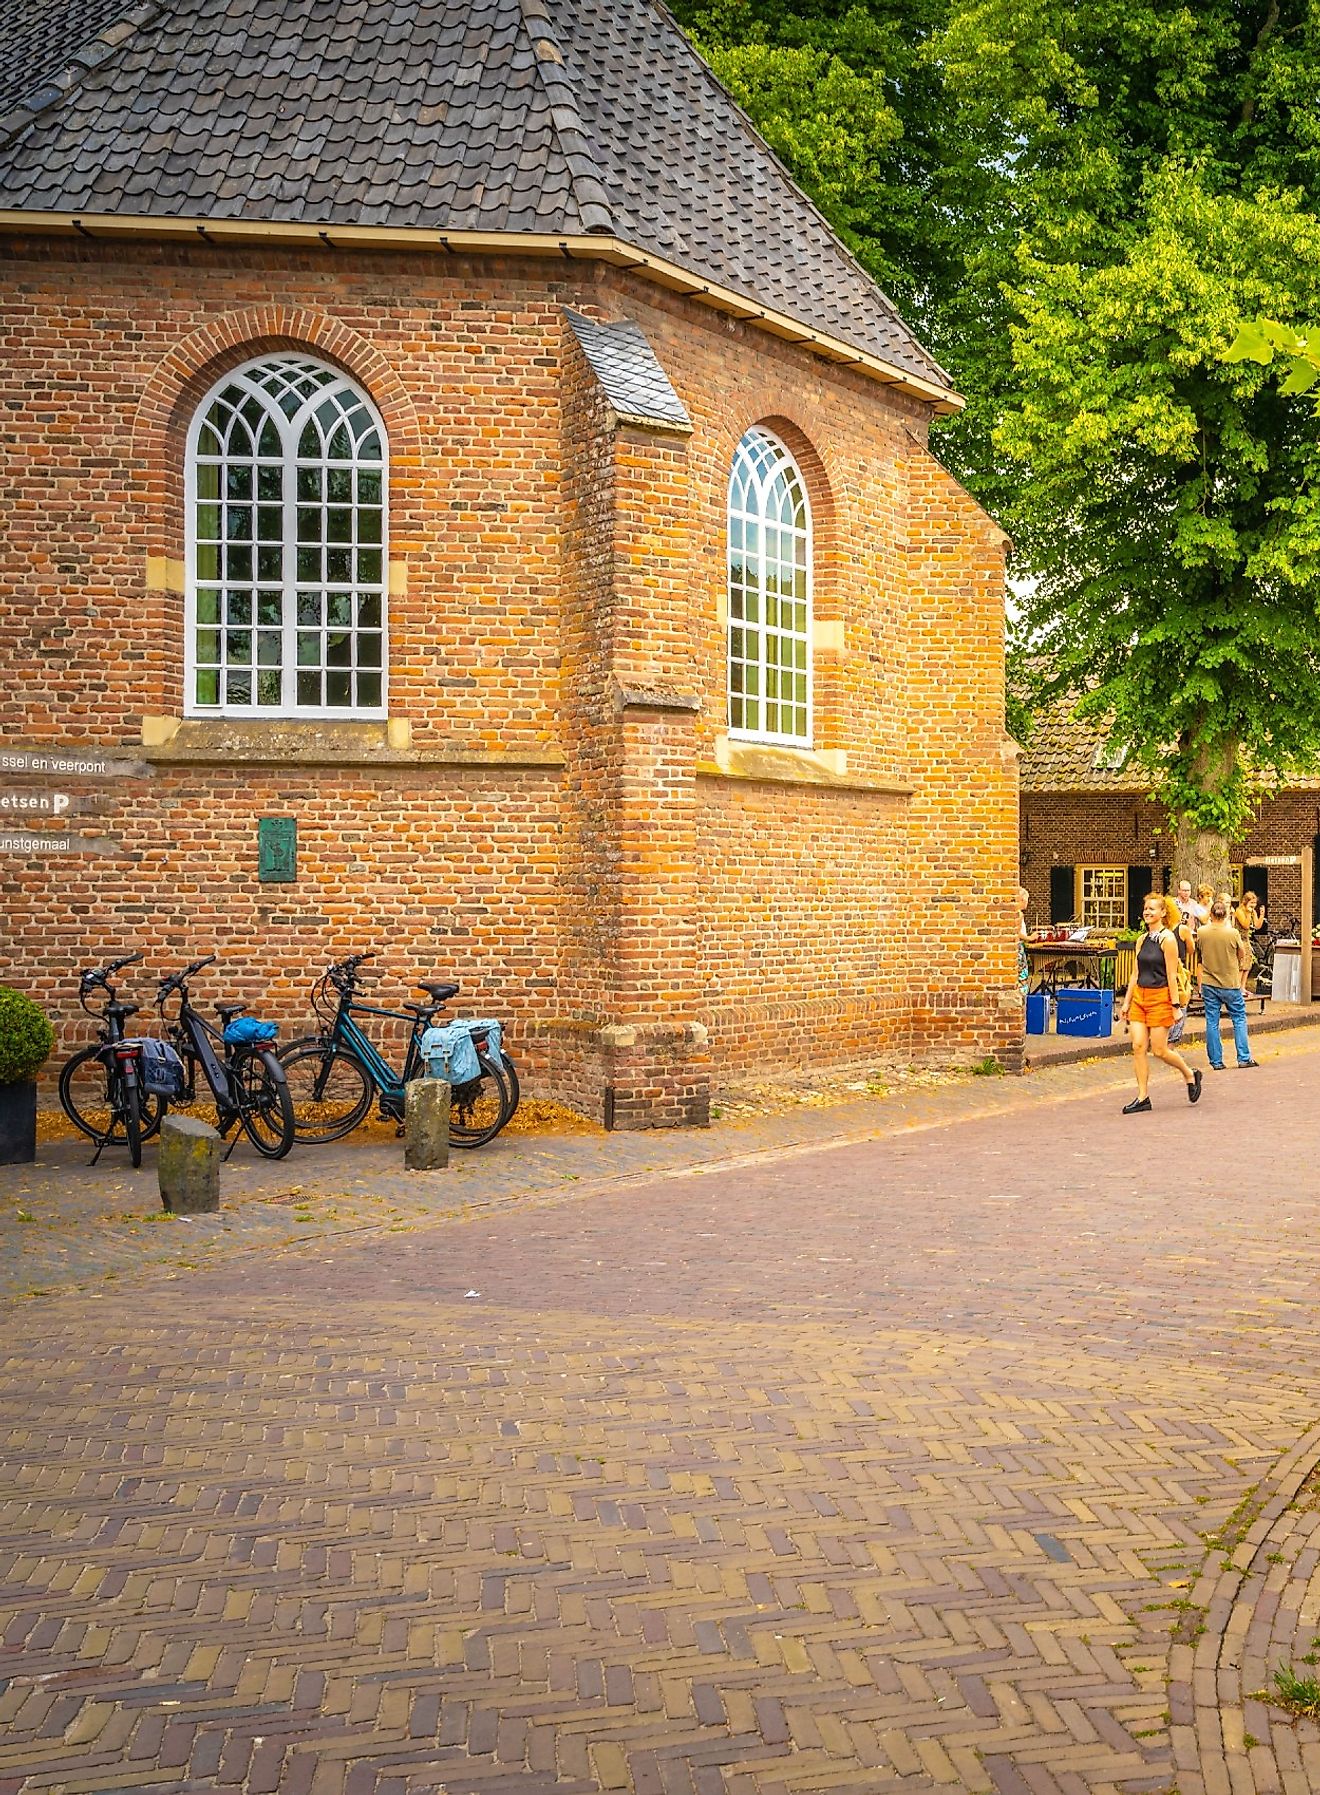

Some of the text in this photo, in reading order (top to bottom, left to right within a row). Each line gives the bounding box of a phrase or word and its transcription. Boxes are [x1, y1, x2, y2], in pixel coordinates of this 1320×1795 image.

[31, 758, 48, 769] en
[51, 760, 106, 774] veerpont
[53, 794, 70, 814] P
